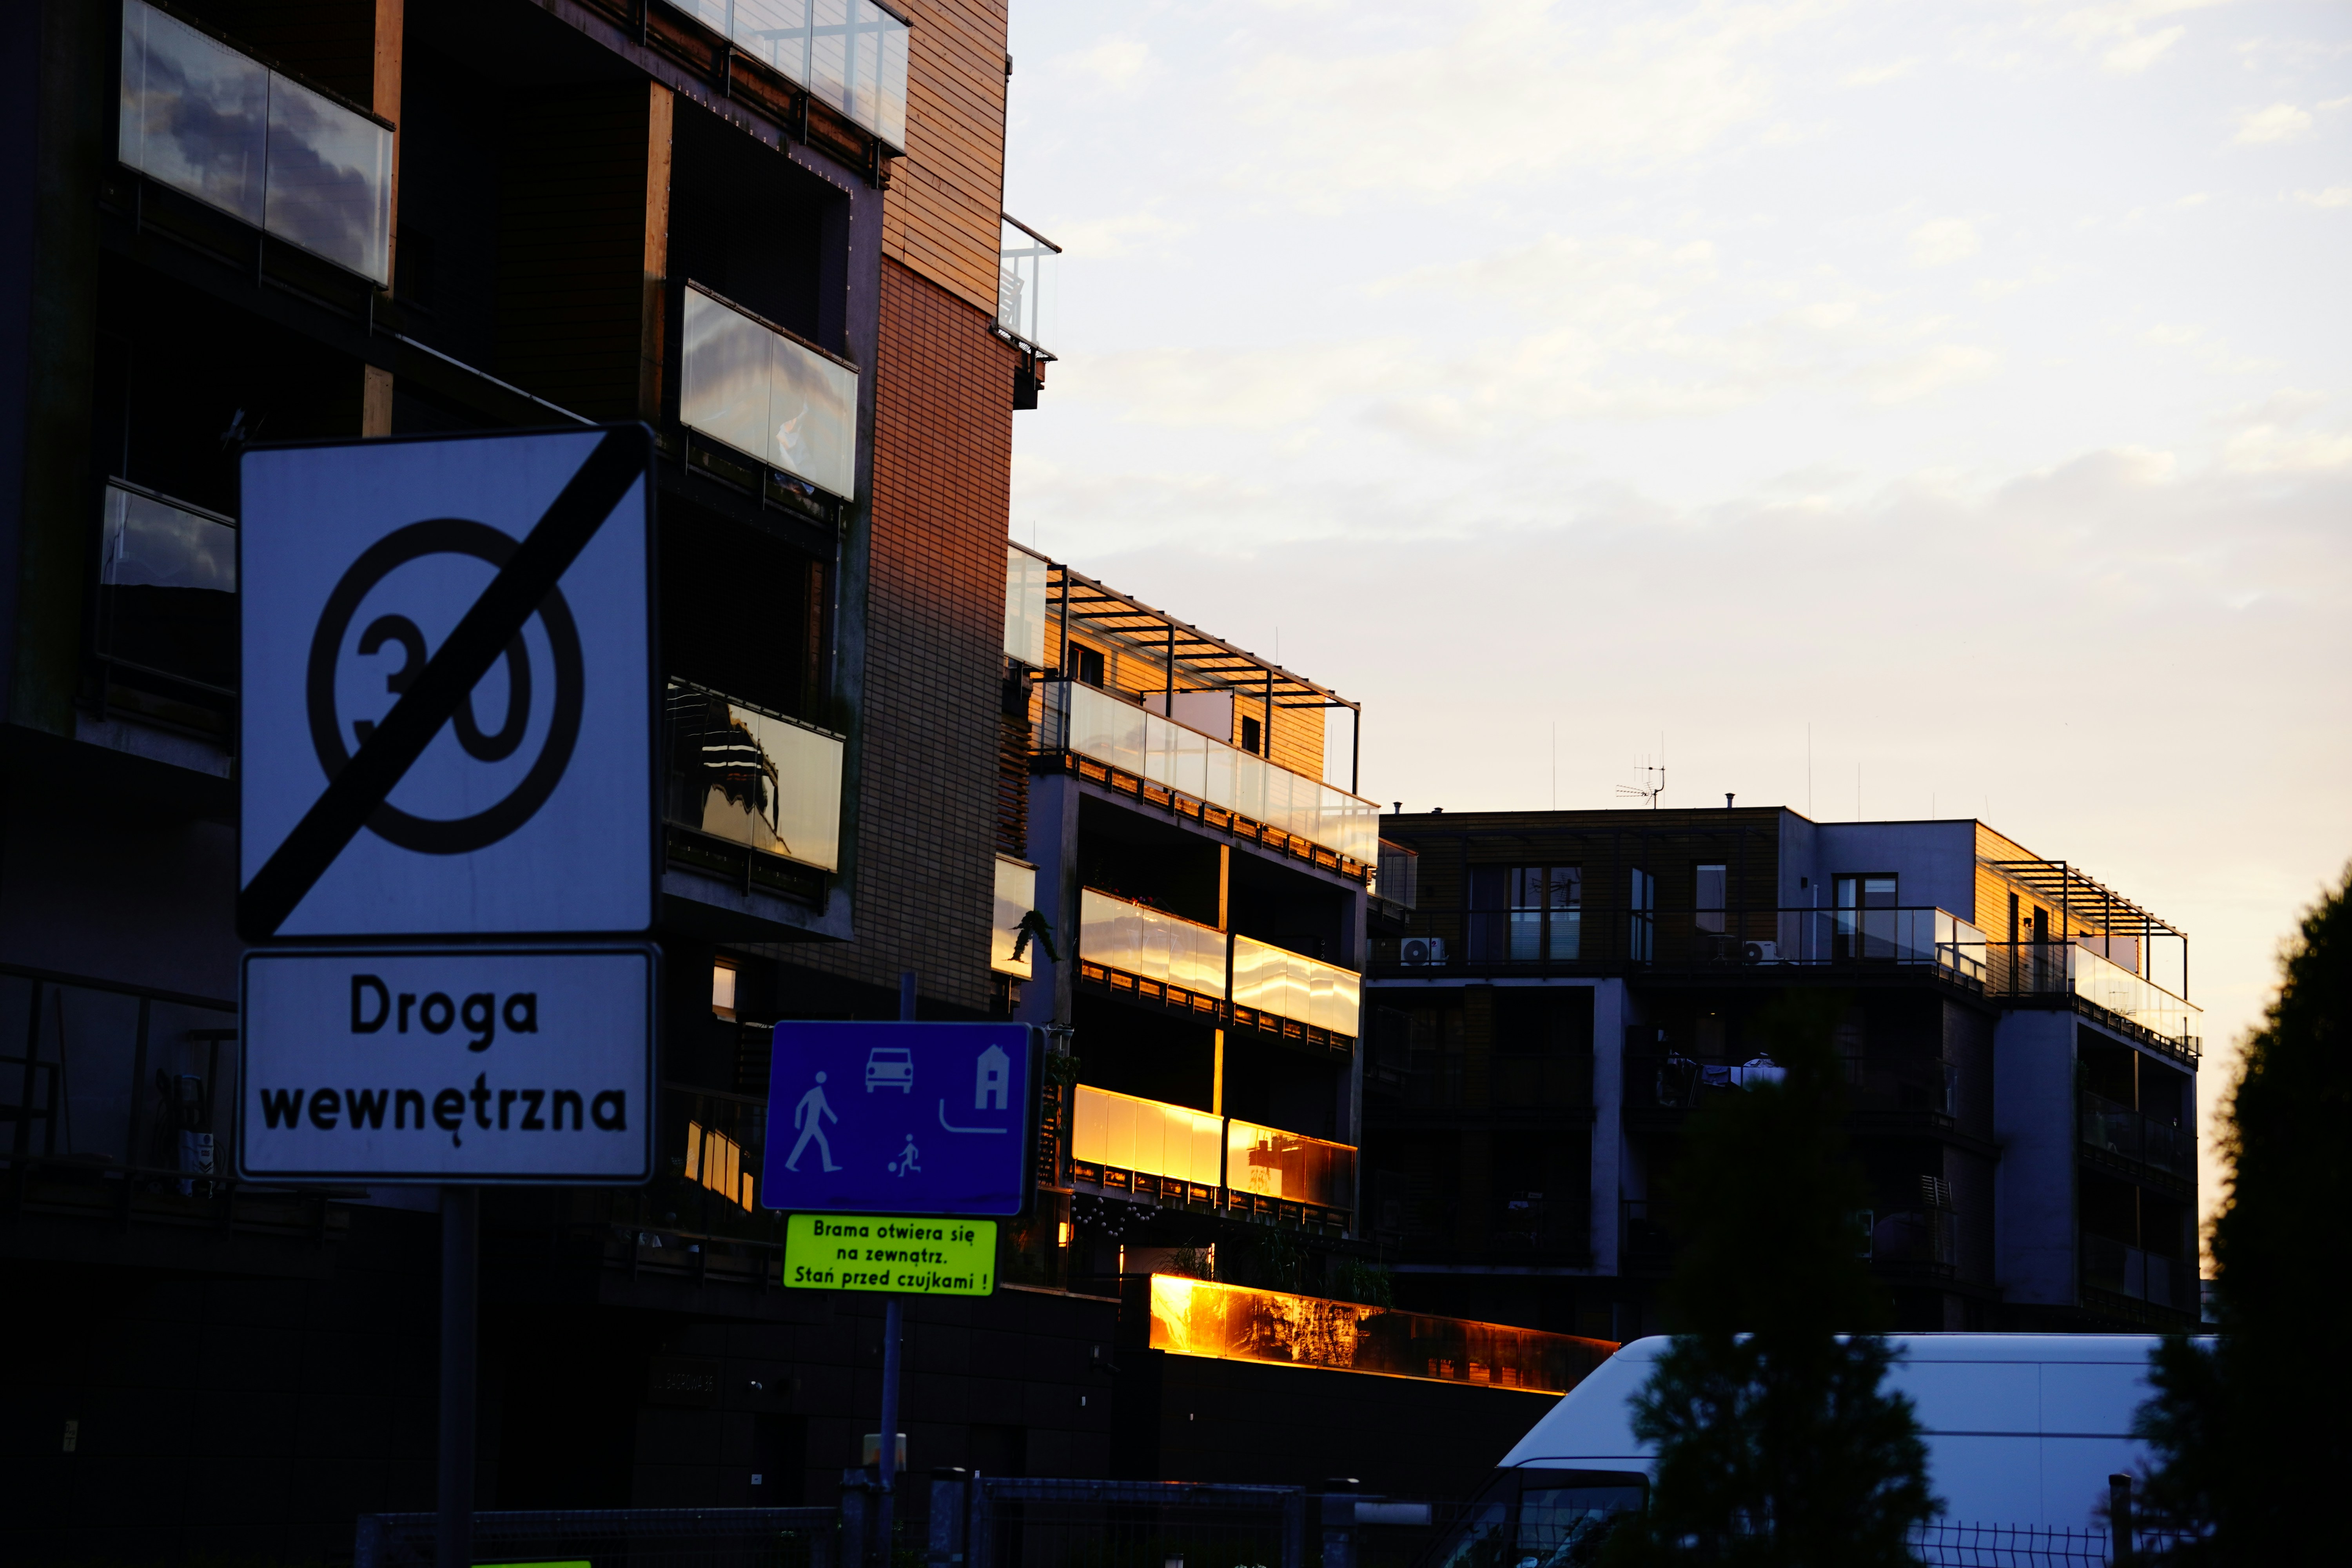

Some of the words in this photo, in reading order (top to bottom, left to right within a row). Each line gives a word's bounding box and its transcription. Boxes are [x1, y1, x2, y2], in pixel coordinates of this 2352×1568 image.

[351, 975, 538, 1053] Droga
[260, 1073, 627, 1148] wewnętrzna
[814, 1220, 869, 1238] Brama
[877, 1223, 943, 1240] otwiera
[951, 1225, 975, 1247] się
[837, 1249, 858, 1260] na
[866, 1249, 948, 1267] zewnątrz.
[795, 1266, 834, 1283] Stań
[842, 1270, 890, 1289] przed
[898, 1272, 973, 1291] czujkami
[704, 1375, 713, 1392] 36
